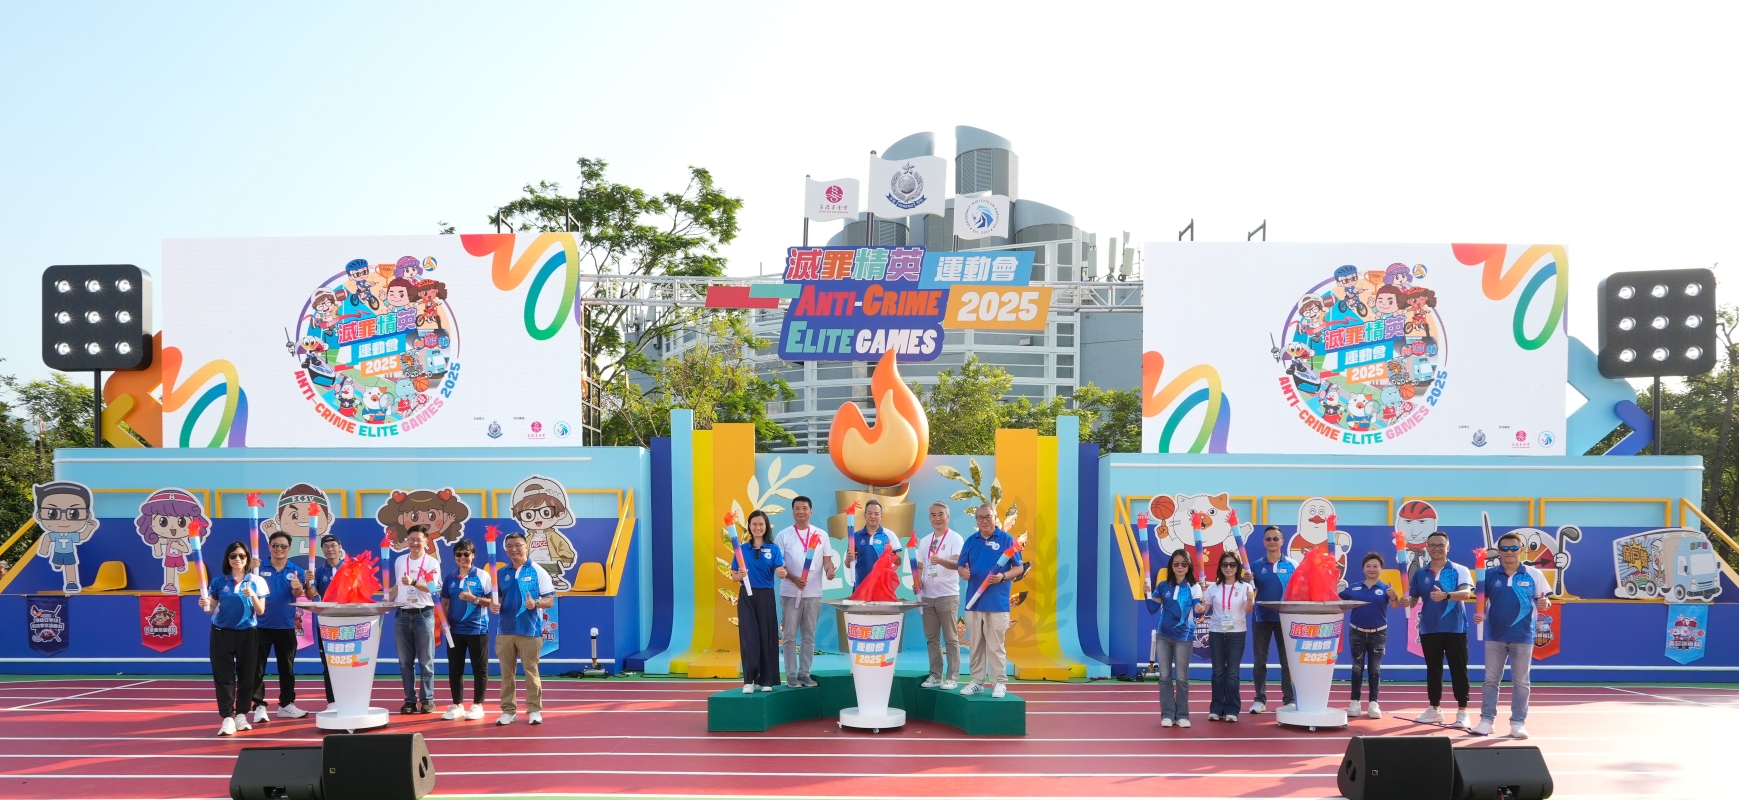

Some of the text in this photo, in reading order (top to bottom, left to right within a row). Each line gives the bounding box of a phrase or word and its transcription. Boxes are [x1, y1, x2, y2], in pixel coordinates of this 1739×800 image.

[786, 247, 1019, 282] 滅罪精英 運動會
[794, 284, 1039, 322] ANTI-CRIME 2025
[338, 308, 417, 344] 滅罪精英
[1325, 315, 1405, 350] 滅罪精英
[785, 320, 938, 355] ELITE GAMES
[358, 338, 398, 358] 運動會
[1345, 345, 1386, 365] 運動會
[365, 355, 397, 374] 2025
[1351, 363, 1384, 381] 2025
[358, 425, 399, 437] ELITE
[401, 397, 444, 432] GAMES
[440, 362, 460, 399] 2025
[1342, 432, 1383, 445] ELITE
[1385, 405, 1430, 440] GAMES
[1426, 370, 1448, 407] 2025
[59, 539, 69, 549] T
[848, 622, 898, 640] 滅罪精英
[330, 655, 353, 665] 2025
[858, 654, 882, 665] 2025
[1303, 652, 1329, 663] 2025
